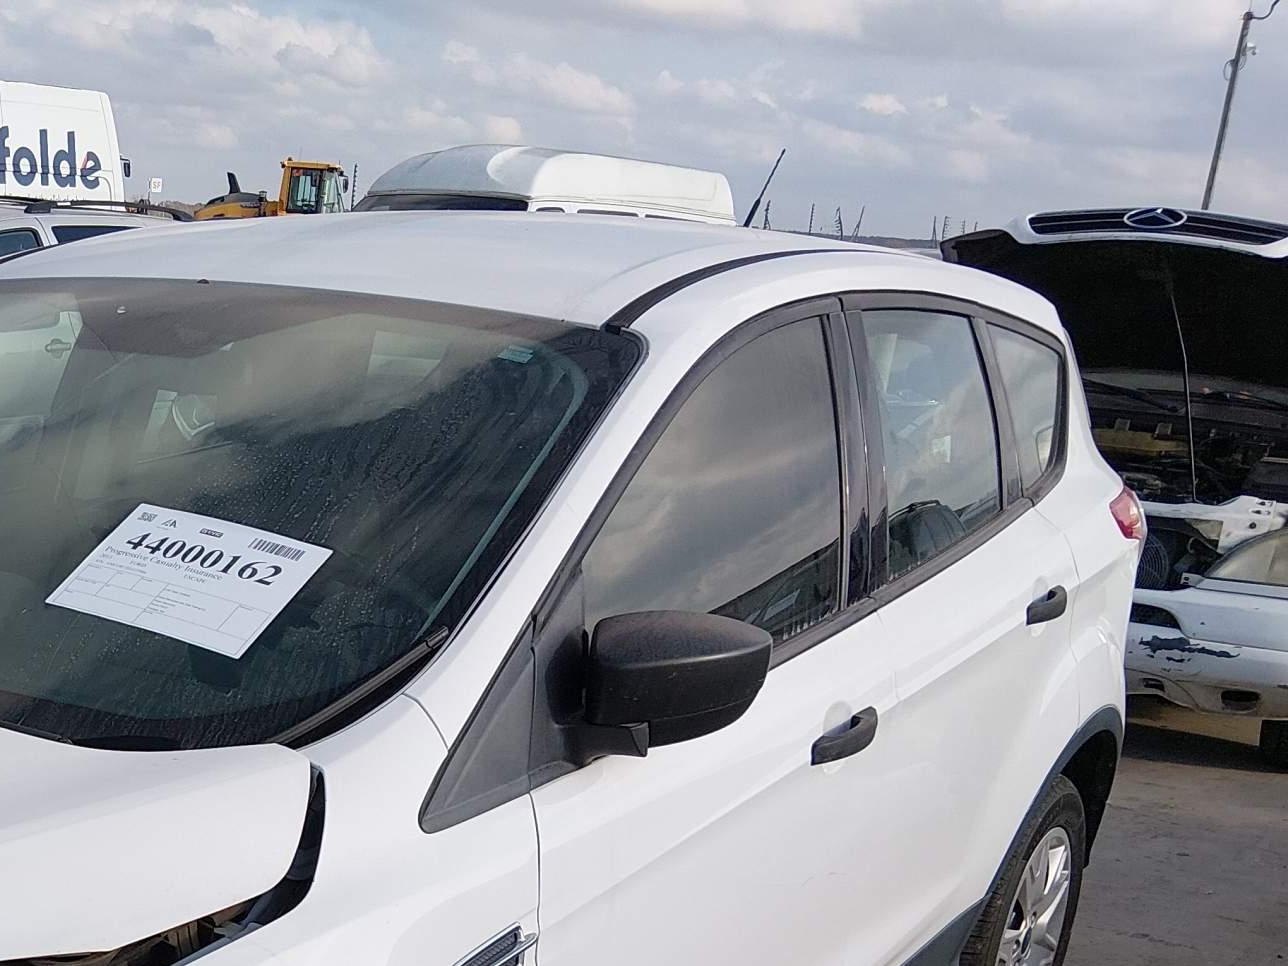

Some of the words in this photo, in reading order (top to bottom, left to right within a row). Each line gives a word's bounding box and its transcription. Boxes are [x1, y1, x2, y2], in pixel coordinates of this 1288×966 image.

[104, 546, 150, 562] Progressive
[149, 555, 183, 571] Casualty
[183, 565, 224, 581] Insurance
[125, 532, 283, 586] 44000162
